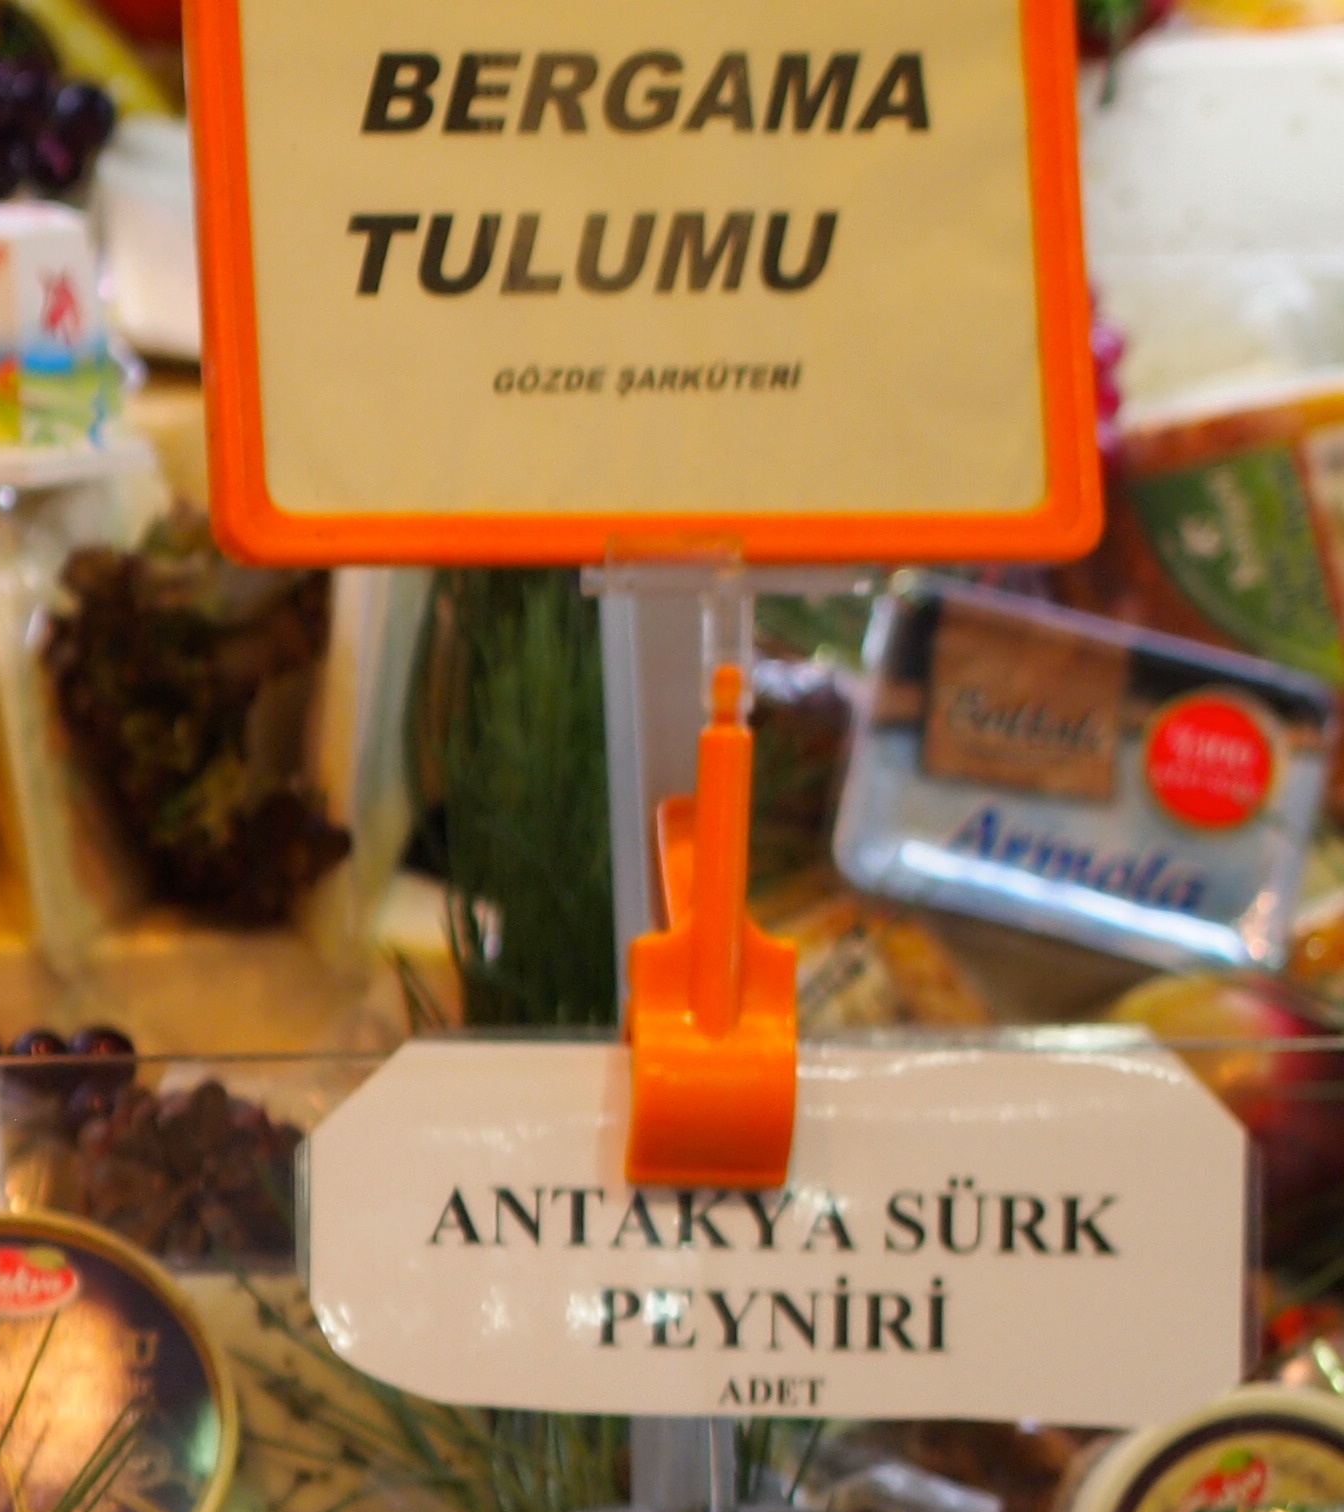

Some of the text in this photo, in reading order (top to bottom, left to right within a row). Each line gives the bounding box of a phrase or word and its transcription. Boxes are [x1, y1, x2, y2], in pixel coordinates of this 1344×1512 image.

[361, 49, 931, 136] BERGAMA
[346, 210, 839, 298] TULUMU
[492, 359, 802, 399] GÖZDE ŞARKÜTERİ
[429, 1177, 1119, 1256] ANTAKYA SÜRK
[597, 1275, 952, 1352] PEYNİRİ
[719, 1375, 826, 1407] ADET
